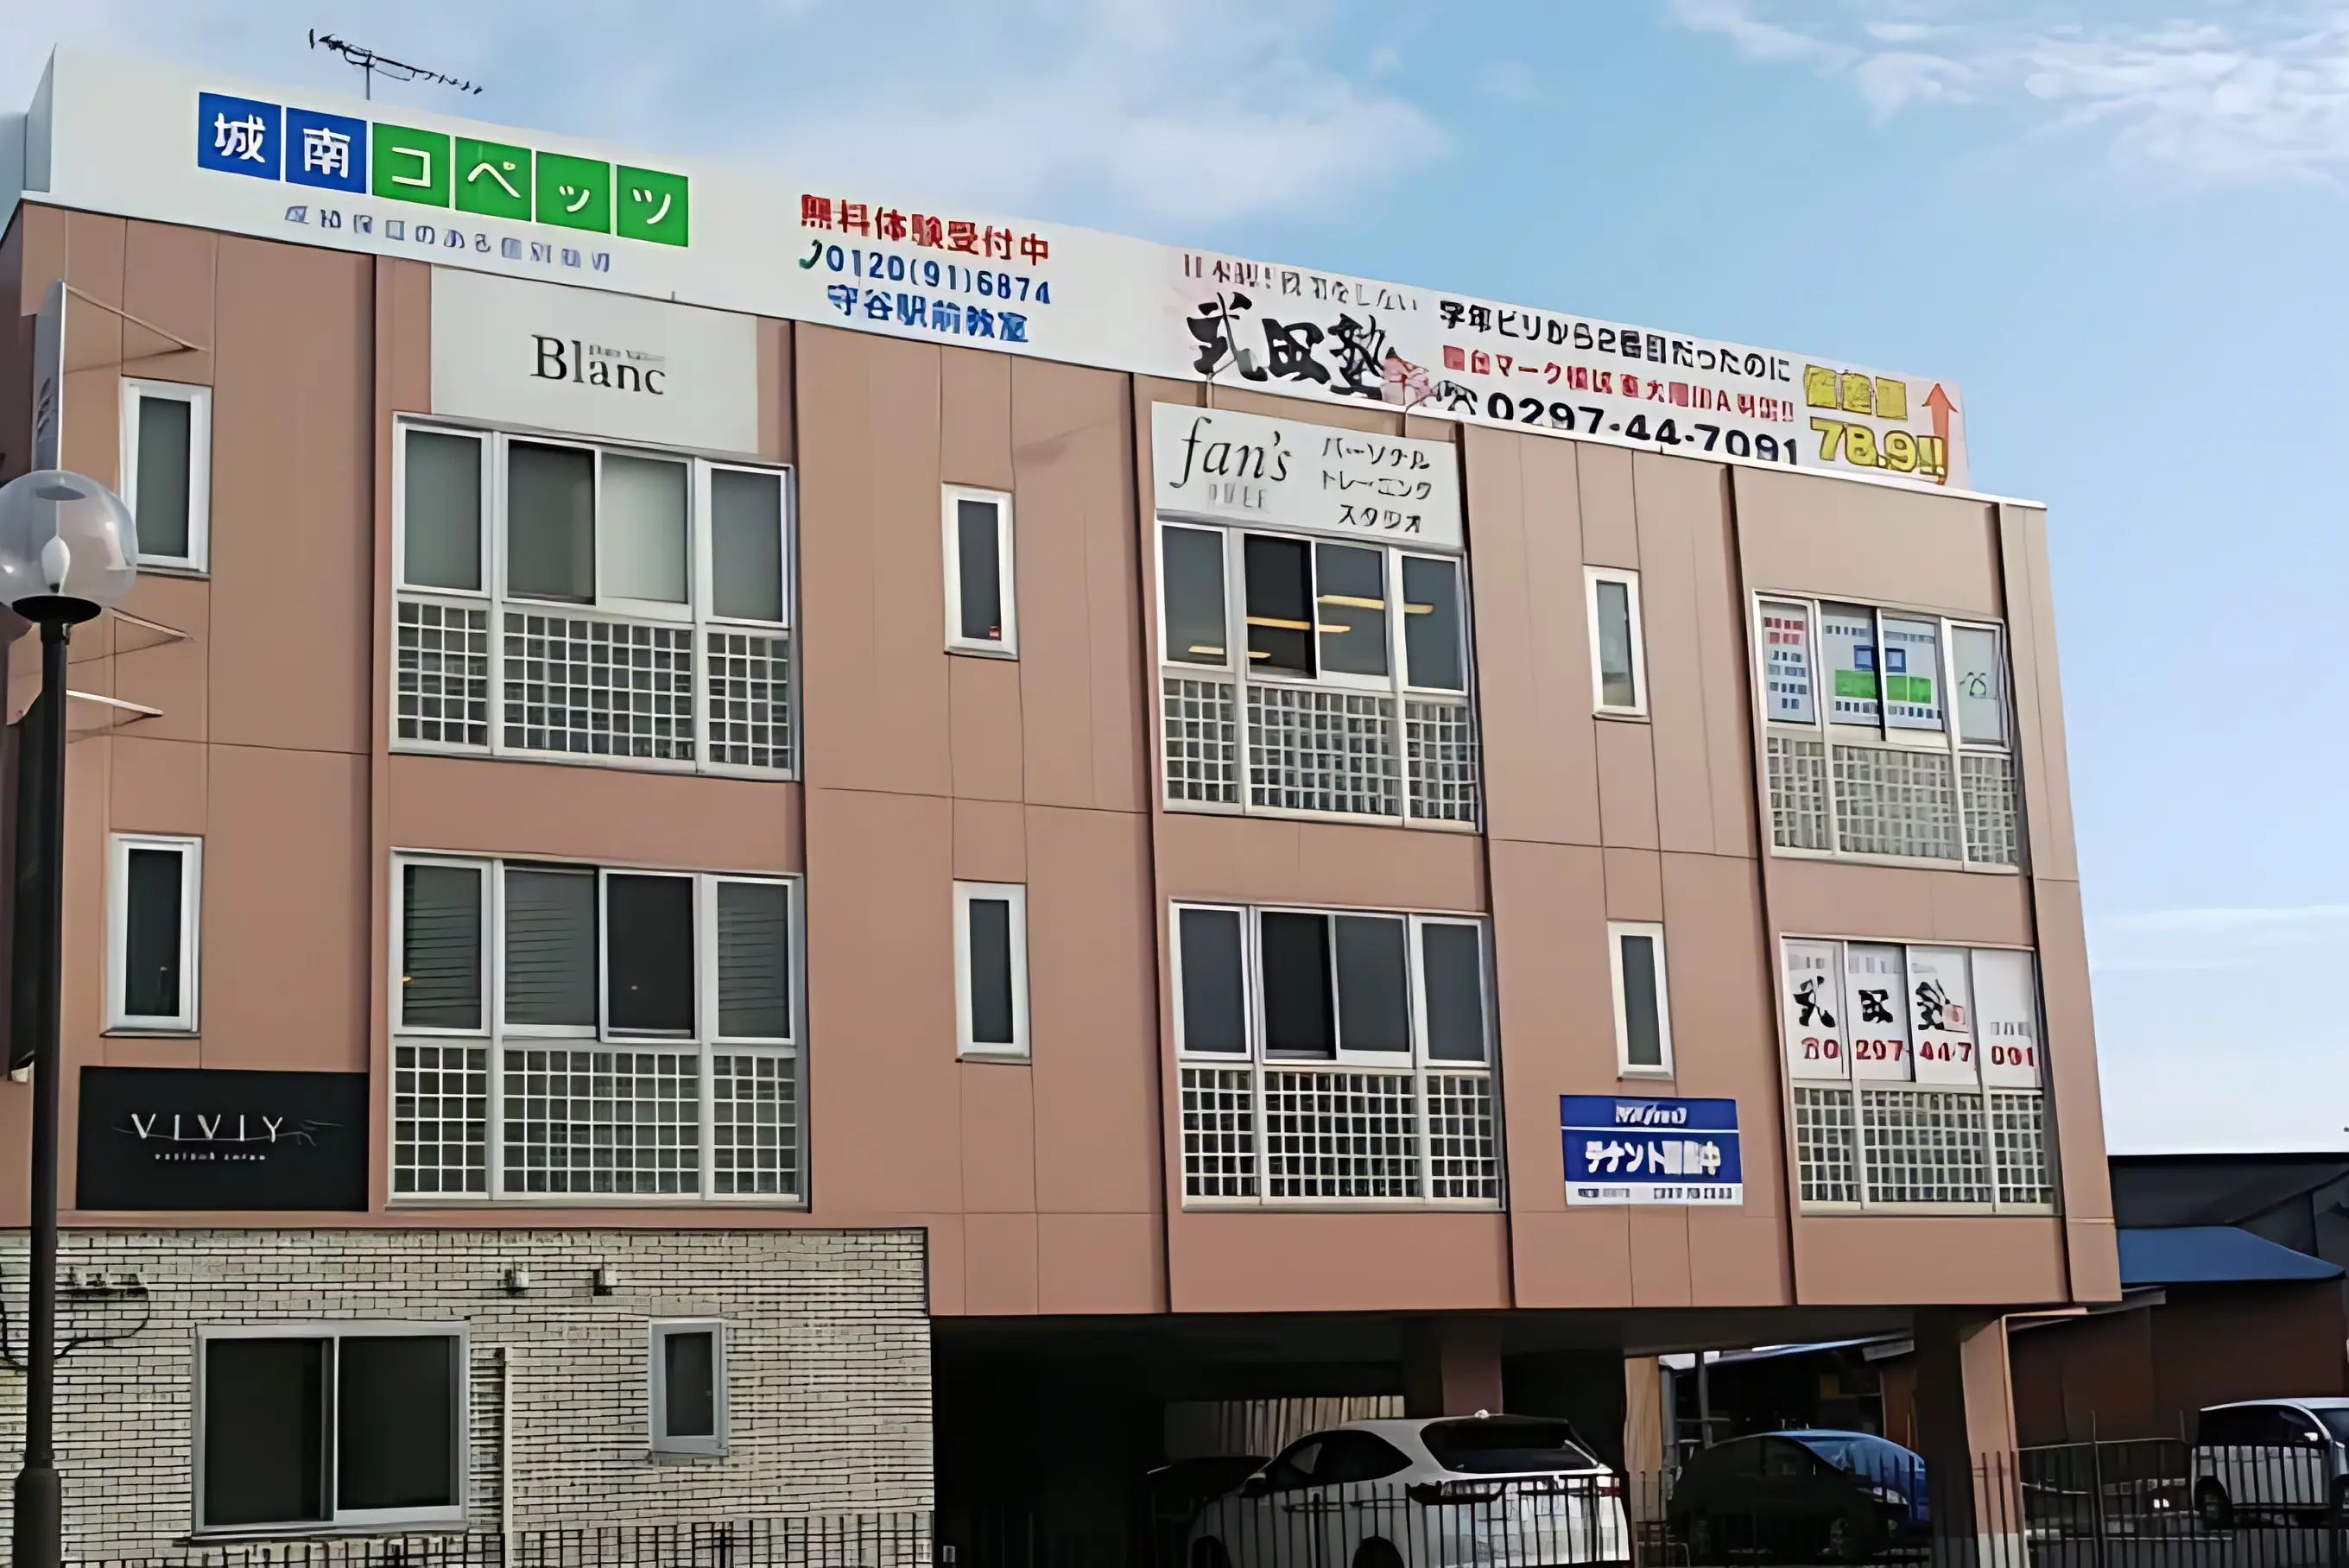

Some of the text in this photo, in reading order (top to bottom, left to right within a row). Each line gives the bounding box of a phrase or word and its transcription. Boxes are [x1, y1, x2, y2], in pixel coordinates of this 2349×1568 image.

[529, 333, 667, 395] Blanc
[1168, 416, 1294, 489] fan's
[131, 1113, 283, 1142] VIVIY
[1585, 1140, 1722, 1176] テナント中
